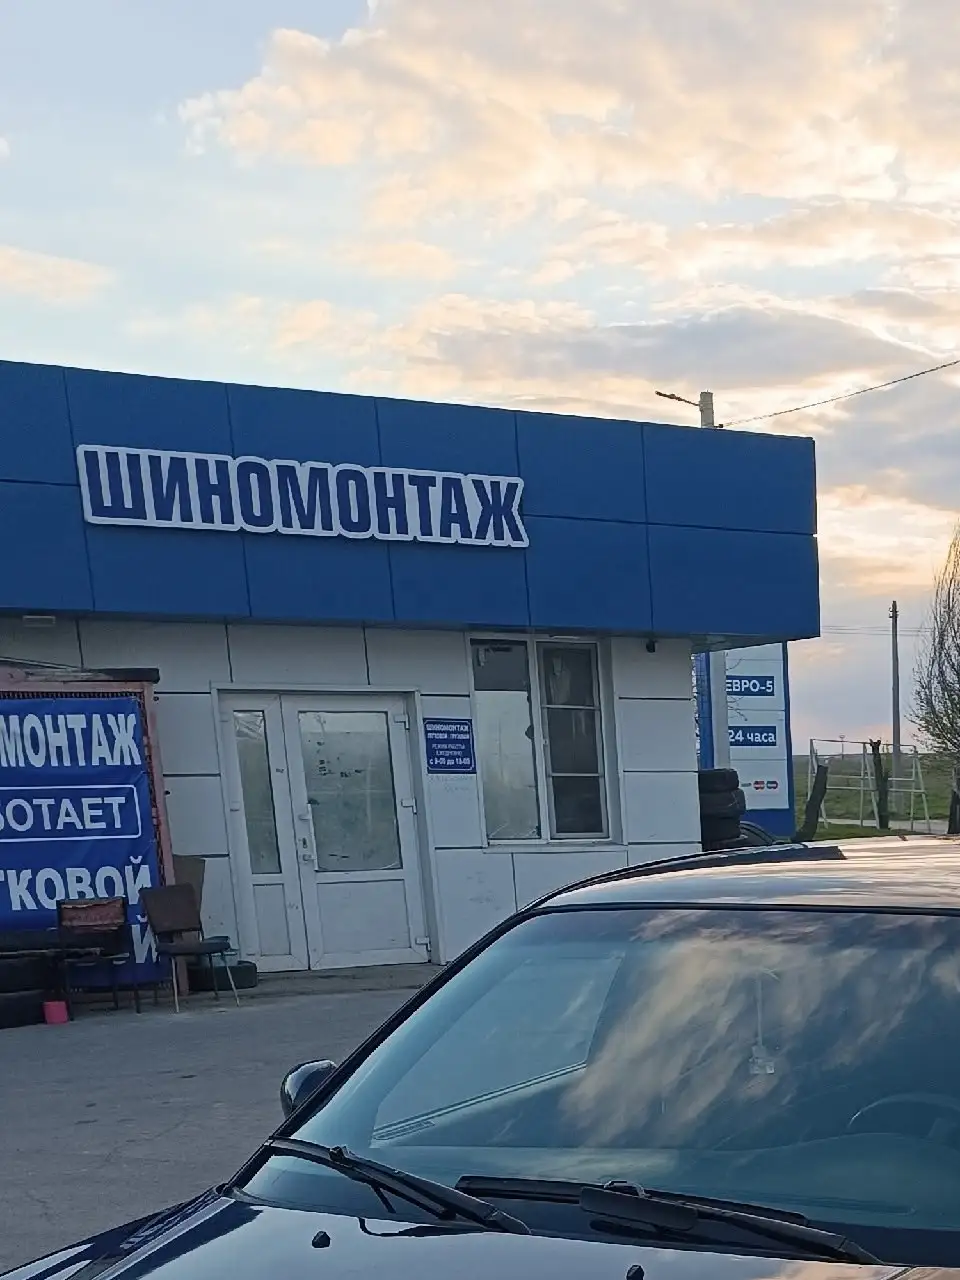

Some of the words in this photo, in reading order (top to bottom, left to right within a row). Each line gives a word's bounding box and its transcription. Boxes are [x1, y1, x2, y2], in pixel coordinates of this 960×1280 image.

[82, 448, 526, 545] ШИНОМОНТАЖ
[726, 679, 773, 692] ЕВРО-5
[0, 713, 142, 768] МОНТАЖ
[728, 729, 744, 742] 24
[746, 732, 775, 743] часа
[0, 797, 125, 832] ОТАЕТ
[0, 855, 152, 911] КОВОЙ
